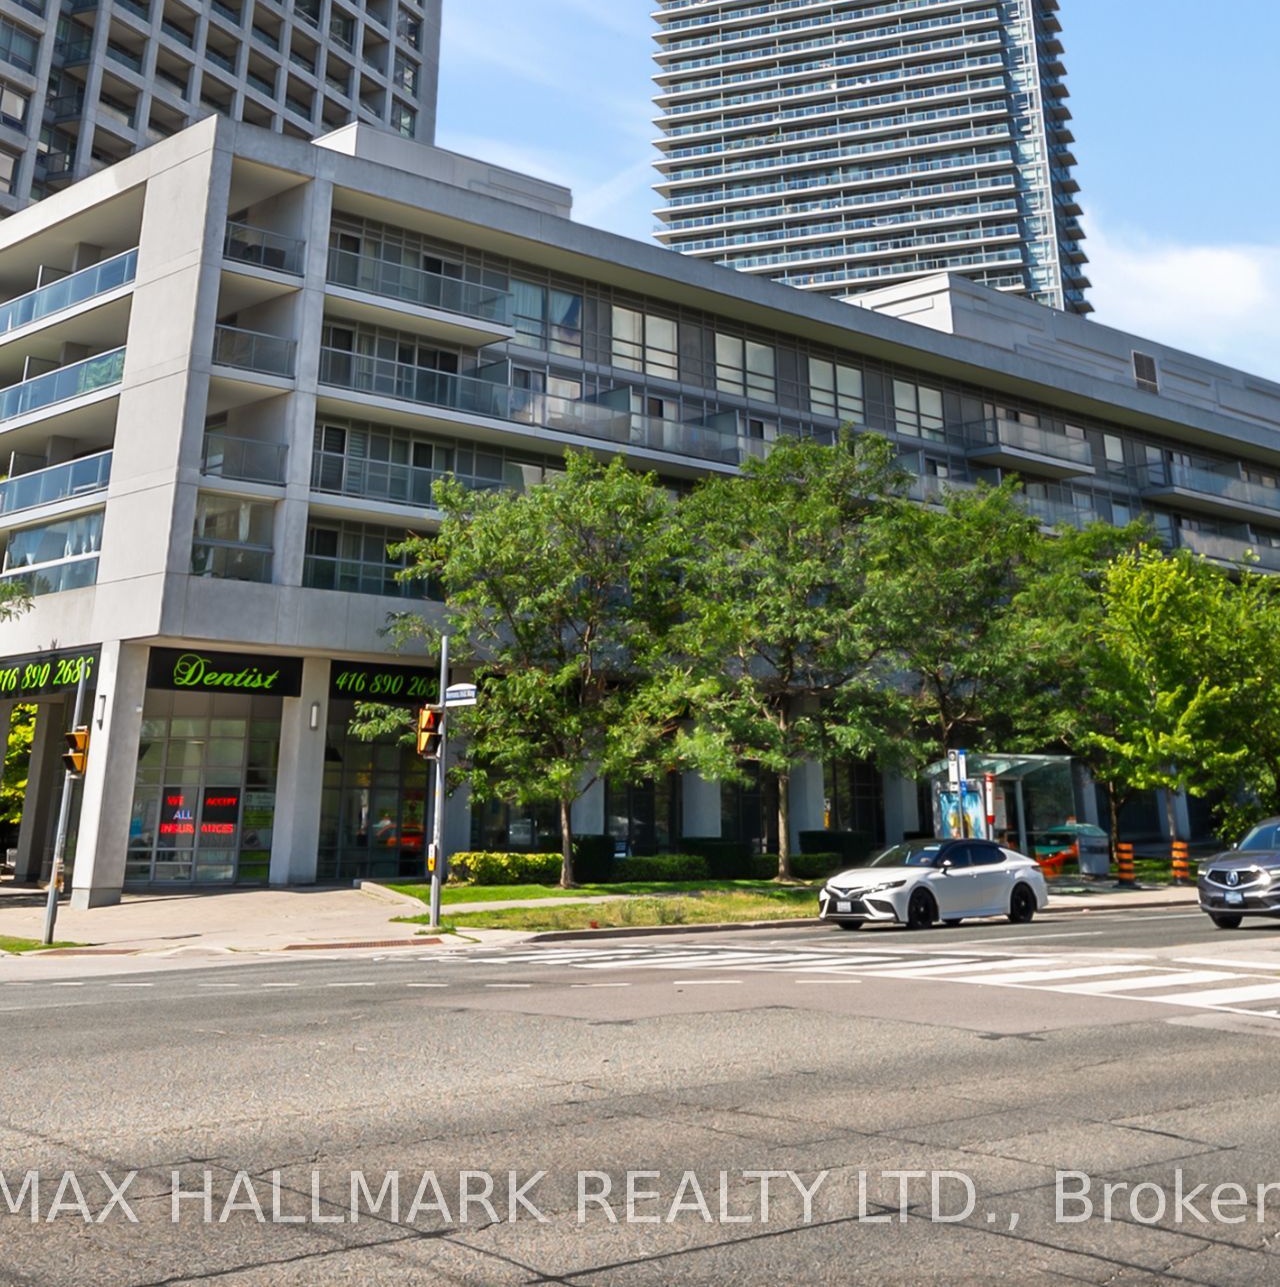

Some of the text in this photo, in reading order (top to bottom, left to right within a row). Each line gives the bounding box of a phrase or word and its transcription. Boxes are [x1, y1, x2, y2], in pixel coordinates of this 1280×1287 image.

[21, 663, 51, 689] 890
[173, 653, 280, 689] Dentist
[335, 671, 368, 692] 416
[369, 673, 404, 695] 890
[167, 795, 185, 806] WE
[172, 809, 194, 820] ALL
